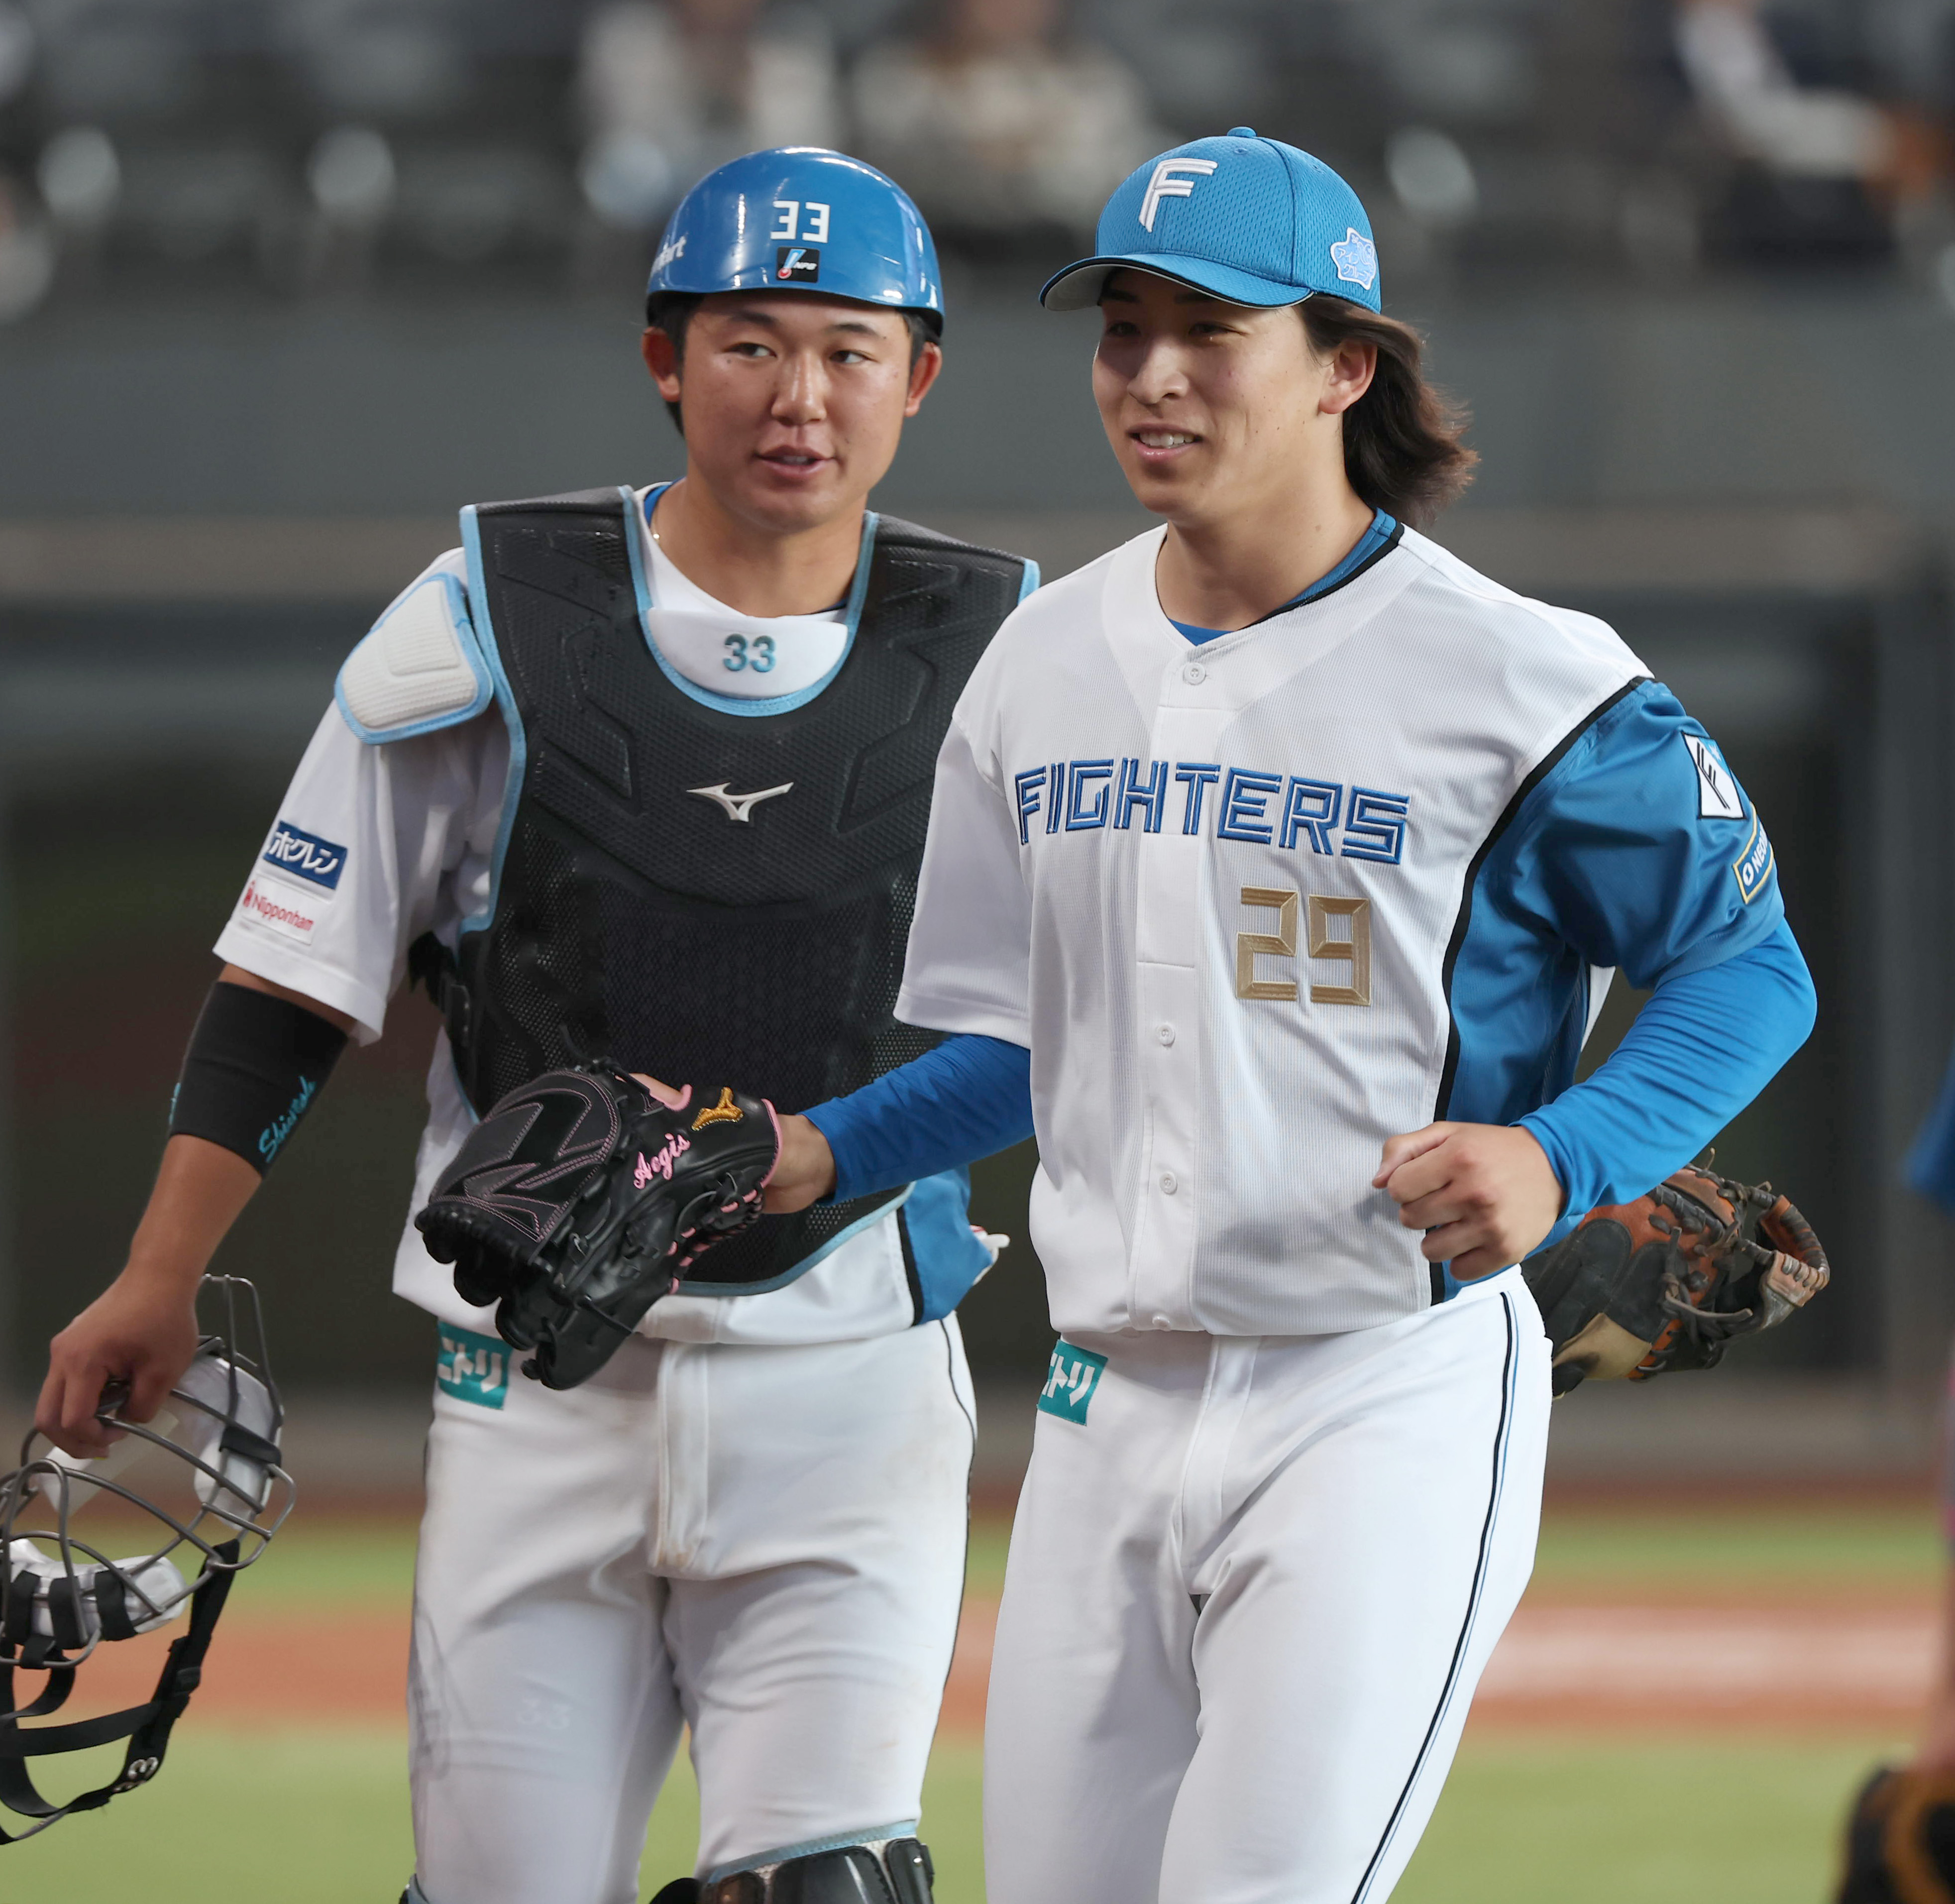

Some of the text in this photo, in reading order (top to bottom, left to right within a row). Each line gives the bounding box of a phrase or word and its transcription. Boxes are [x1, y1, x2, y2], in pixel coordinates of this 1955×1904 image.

[770, 200, 830, 243] 33
[1139, 157, 1218, 232] F
[723, 633, 776, 672] 33
[1015, 758, 1410, 865] FIGHTERS
[268, 831, 338, 874] ホクレン
[251, 893, 315, 931] Nipponham
[1236, 886, 1371, 1007] 29
[634, 1133, 691, 1190] Aegis
[437, 1336, 502, 1393] ニトリ
